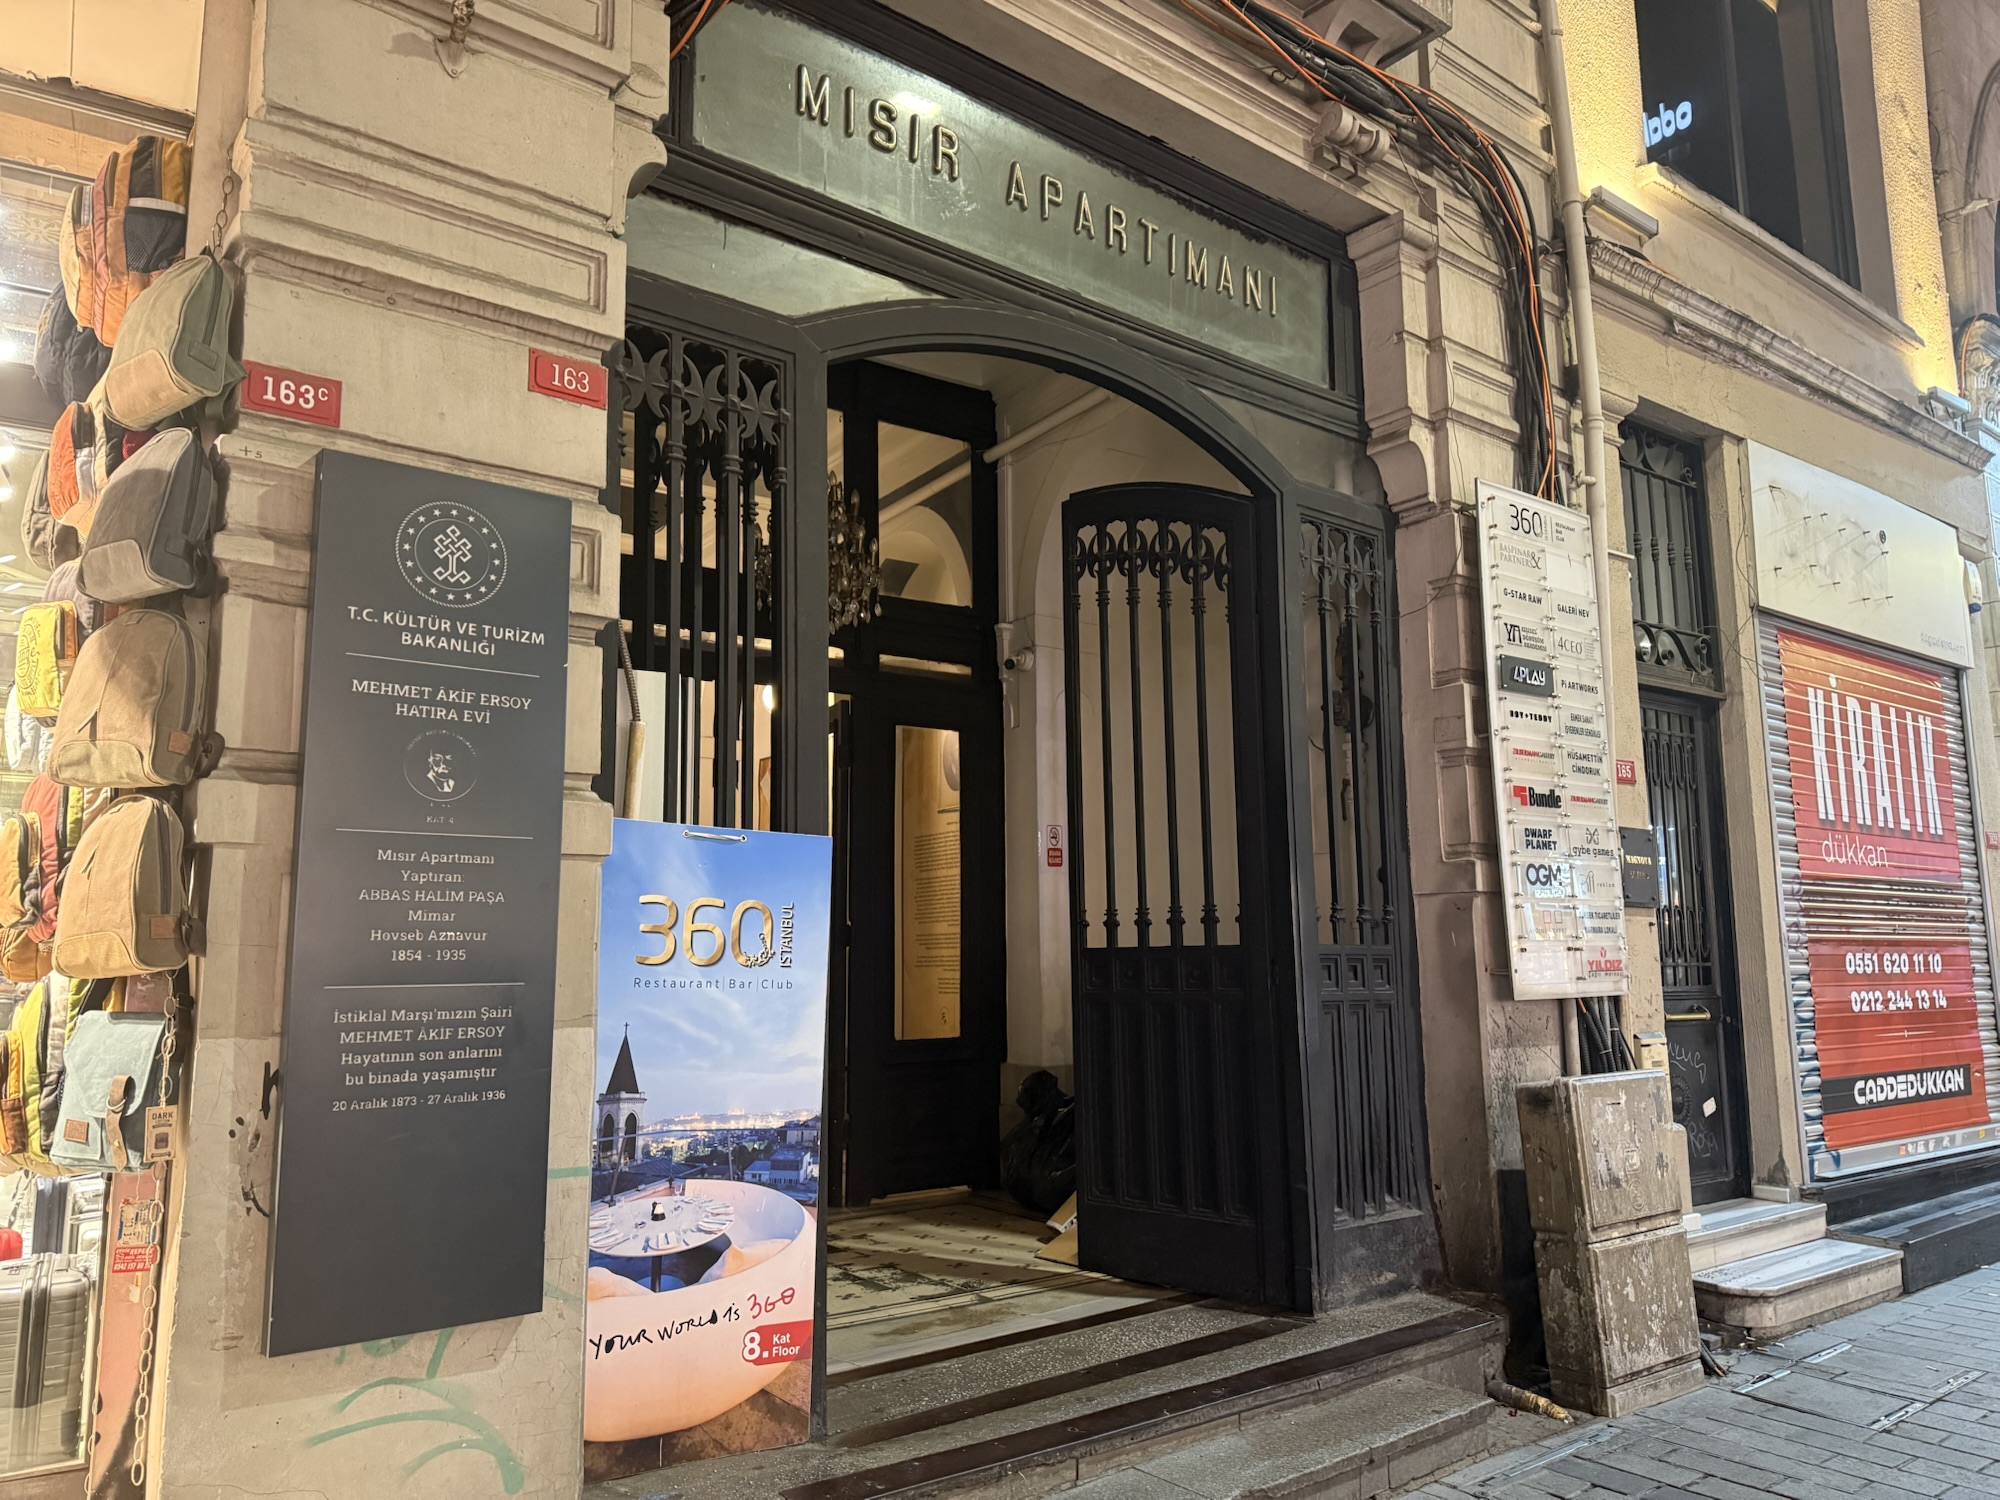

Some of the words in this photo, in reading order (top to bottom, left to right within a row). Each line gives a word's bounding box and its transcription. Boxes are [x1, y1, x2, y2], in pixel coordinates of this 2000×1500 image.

[797, 63, 960, 180] MISIR
[1005, 160, 1277, 318] APARTIMANI
[551, 363, 590, 394] 163
[1509, 503, 1543, 538] 360
[1503, 588, 1528, 602] G-STAR
[1528, 594, 1542, 605] RAW
[1557, 603, 1578, 616] GALERİ
[1578, 607, 1590, 618] NEV
[348, 606, 378, 623] T.C.
[383, 610, 451, 633] KÜLTÜR
[456, 620, 477, 637] VE
[482, 623, 546, 646] TURİZM
[401, 630, 496, 657] BAKANLIĞI
[352, 678, 433, 700] MEHMET
[436, 685, 476, 706] ÂKİF
[480, 694, 532, 712] ERSOY
[1568, 680, 1599, 695] ARTWORKS
[395, 703, 459, 722] HATIRA
[463, 708, 491, 725] EVİ
[1566, 748, 1603, 764] HÜSAMETTİN
[1807, 673, 1943, 837] KİRALIK
[1572, 763, 1601, 777] CİNDORUK
[1616, 764, 1632, 778] 165
[1528, 786, 1562, 809] Bundle
[1524, 827, 1552, 840] DWARF
[1525, 840, 1557, 852] PLANET
[1592, 847, 1615, 858] games
[1822, 832, 1889, 868] dükkan
[376, 849, 416, 863] Mısır
[420, 851, 495, 866] Apartmanı
[359, 889, 411, 902] ABBAS
[414, 888, 465, 902] HALİM
[468, 891, 505, 906] PAŞA
[407, 909, 456, 922] Mimar
[370, 929, 424, 942] Hovseb
[428, 930, 488, 942] Aznavur
[635, 893, 775, 968] 360
[779, 901, 795, 969] ISTANBUL
[391, 950, 423, 962] 1854
[435, 949, 467, 962] 1935
[1587, 959, 1623, 971] YILDIZ
[1845, 952, 1879, 975] 0551
[1883, 952, 1909, 974] 620
[1913, 952, 1925, 973] 11
[1928, 952, 1943, 974] 10
[633, 977, 721, 990] Restaurant
[728, 978, 753, 990] Bar
[761, 979, 794, 990] Club
[1851, 990, 1883, 1012] 0212
[1887, 990, 1914, 1011] 244
[1916, 990, 1930, 1010] 13
[1932, 989, 1948, 1009] 14
[333, 1008, 387, 1024] İstiklal
[481, 1005, 513, 1022] Şairi
[339, 1029, 414, 1044] MEHMET
[418, 1026, 454, 1041] ÂKİF
[458, 1026, 506, 1040] ERSOY
[341, 1052, 416, 1067] Hayatının
[419, 1050, 444, 1062] son
[448, 1046, 503, 1060] anlarını
[345, 1072, 364, 1087] bu
[368, 1070, 418, 1084] binada
[422, 1066, 497, 1085] yaşamıştır
[1854, 1067, 1965, 1105] CADDEDUKKAN
[332, 1100, 348, 1112] 20
[350, 1096, 388, 1111] Aralık
[391, 1095, 418, 1108] 1873
[427, 1094, 442, 1106] 27
[444, 1090, 480, 1105] Aralık
[481, 1090, 506, 1102] 1936
[152, 1112, 174, 1120] DARK
[589, 1328, 653, 1360] YOUR
[746, 1286, 796, 1320] 360
[742, 1330, 769, 1362] 8.
[772, 1332, 791, 1345] Kat
[772, 1344, 801, 1359] Floor
